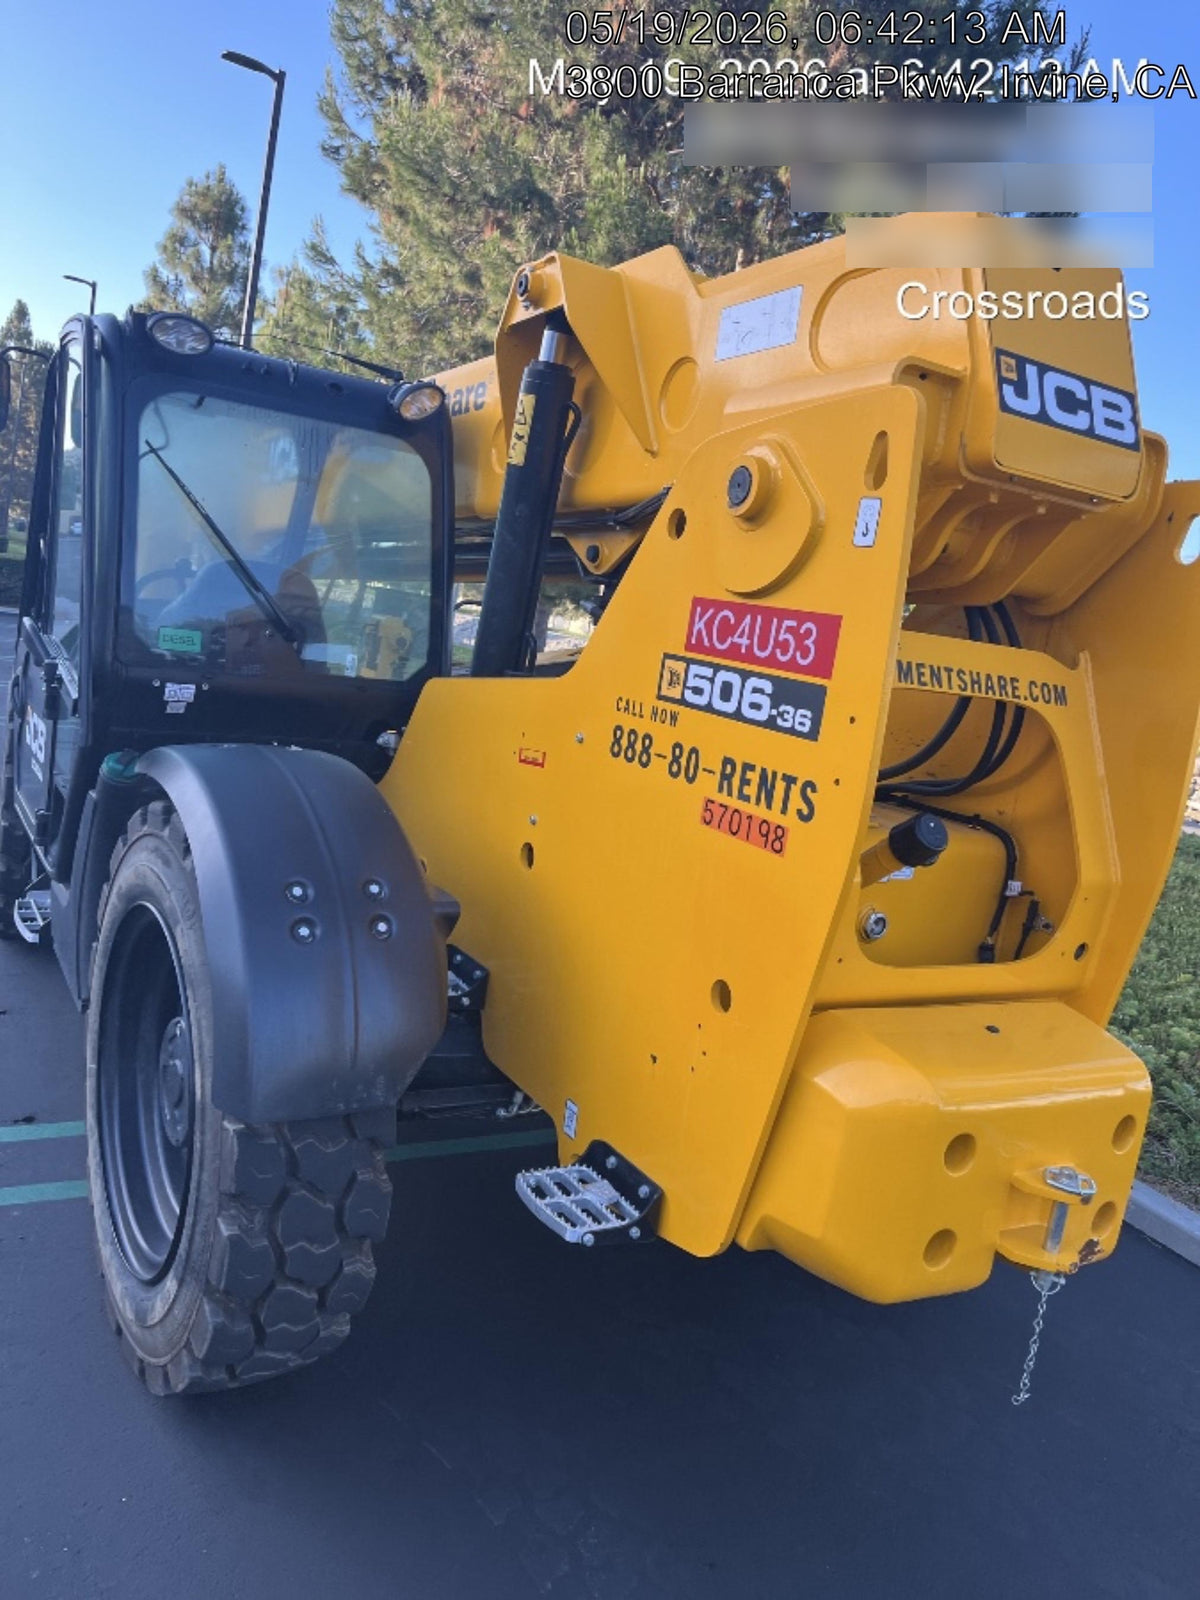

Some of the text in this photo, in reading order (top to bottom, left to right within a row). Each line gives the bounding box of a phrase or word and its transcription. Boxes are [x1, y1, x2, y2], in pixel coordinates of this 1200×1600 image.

[1002, 363, 1137, 444] JCB
[691, 606, 817, 666] KC4U53
[616, 696, 680, 727] CALL NOW
[684, 664, 812, 733] 506-36
[896, 659, 1068, 707] MENTSHARE.COM
[609, 724, 818, 824] 888-80-RENTS
[702, 798, 786, 855] 570198
